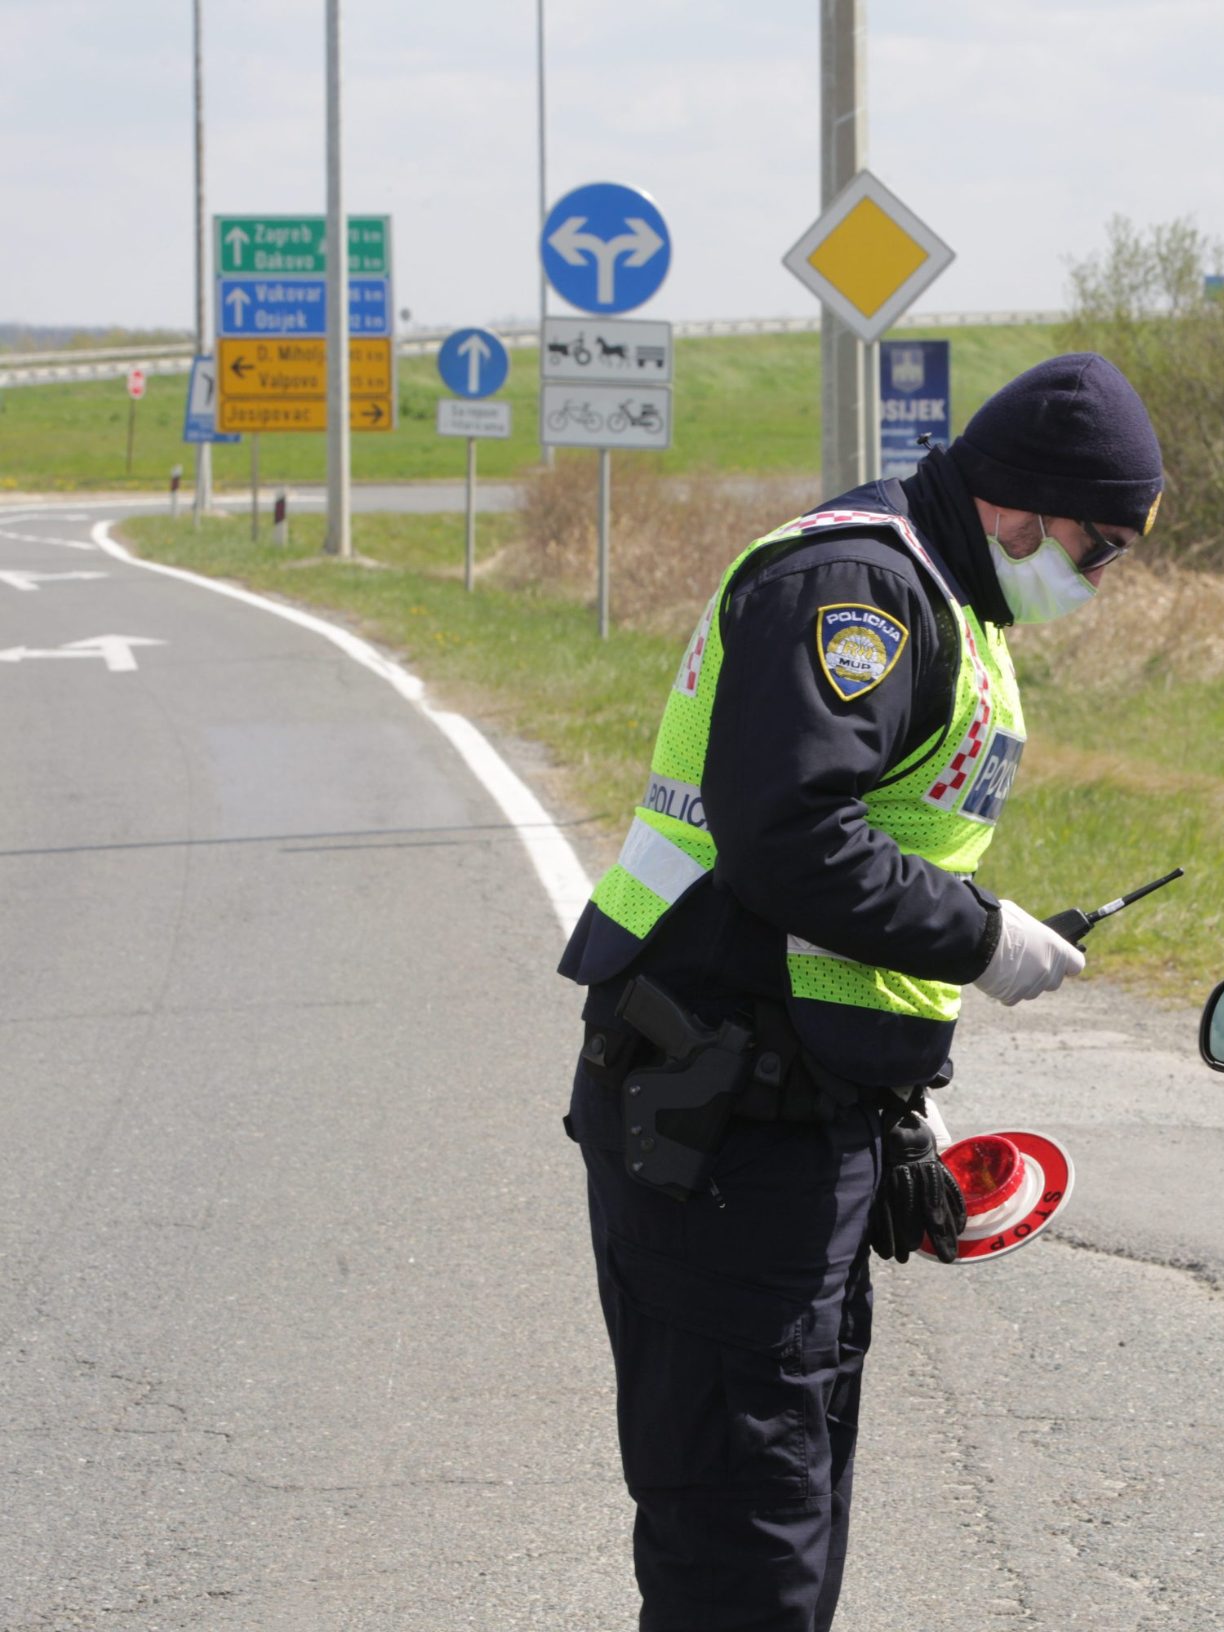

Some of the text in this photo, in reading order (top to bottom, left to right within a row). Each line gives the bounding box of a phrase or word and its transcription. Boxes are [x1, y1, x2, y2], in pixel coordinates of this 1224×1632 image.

[254, 223, 313, 248] Zagreb
[254, 283, 322, 303] Vukovar
[254, 309, 308, 332] Osijek
[259, 370, 319, 393] Valpovo
[826, 611, 901, 642] POLICIJA
[839, 658, 871, 670] MUP
[648, 783, 706, 828] POLIC
[990, 1190, 1063, 1251] STOP
